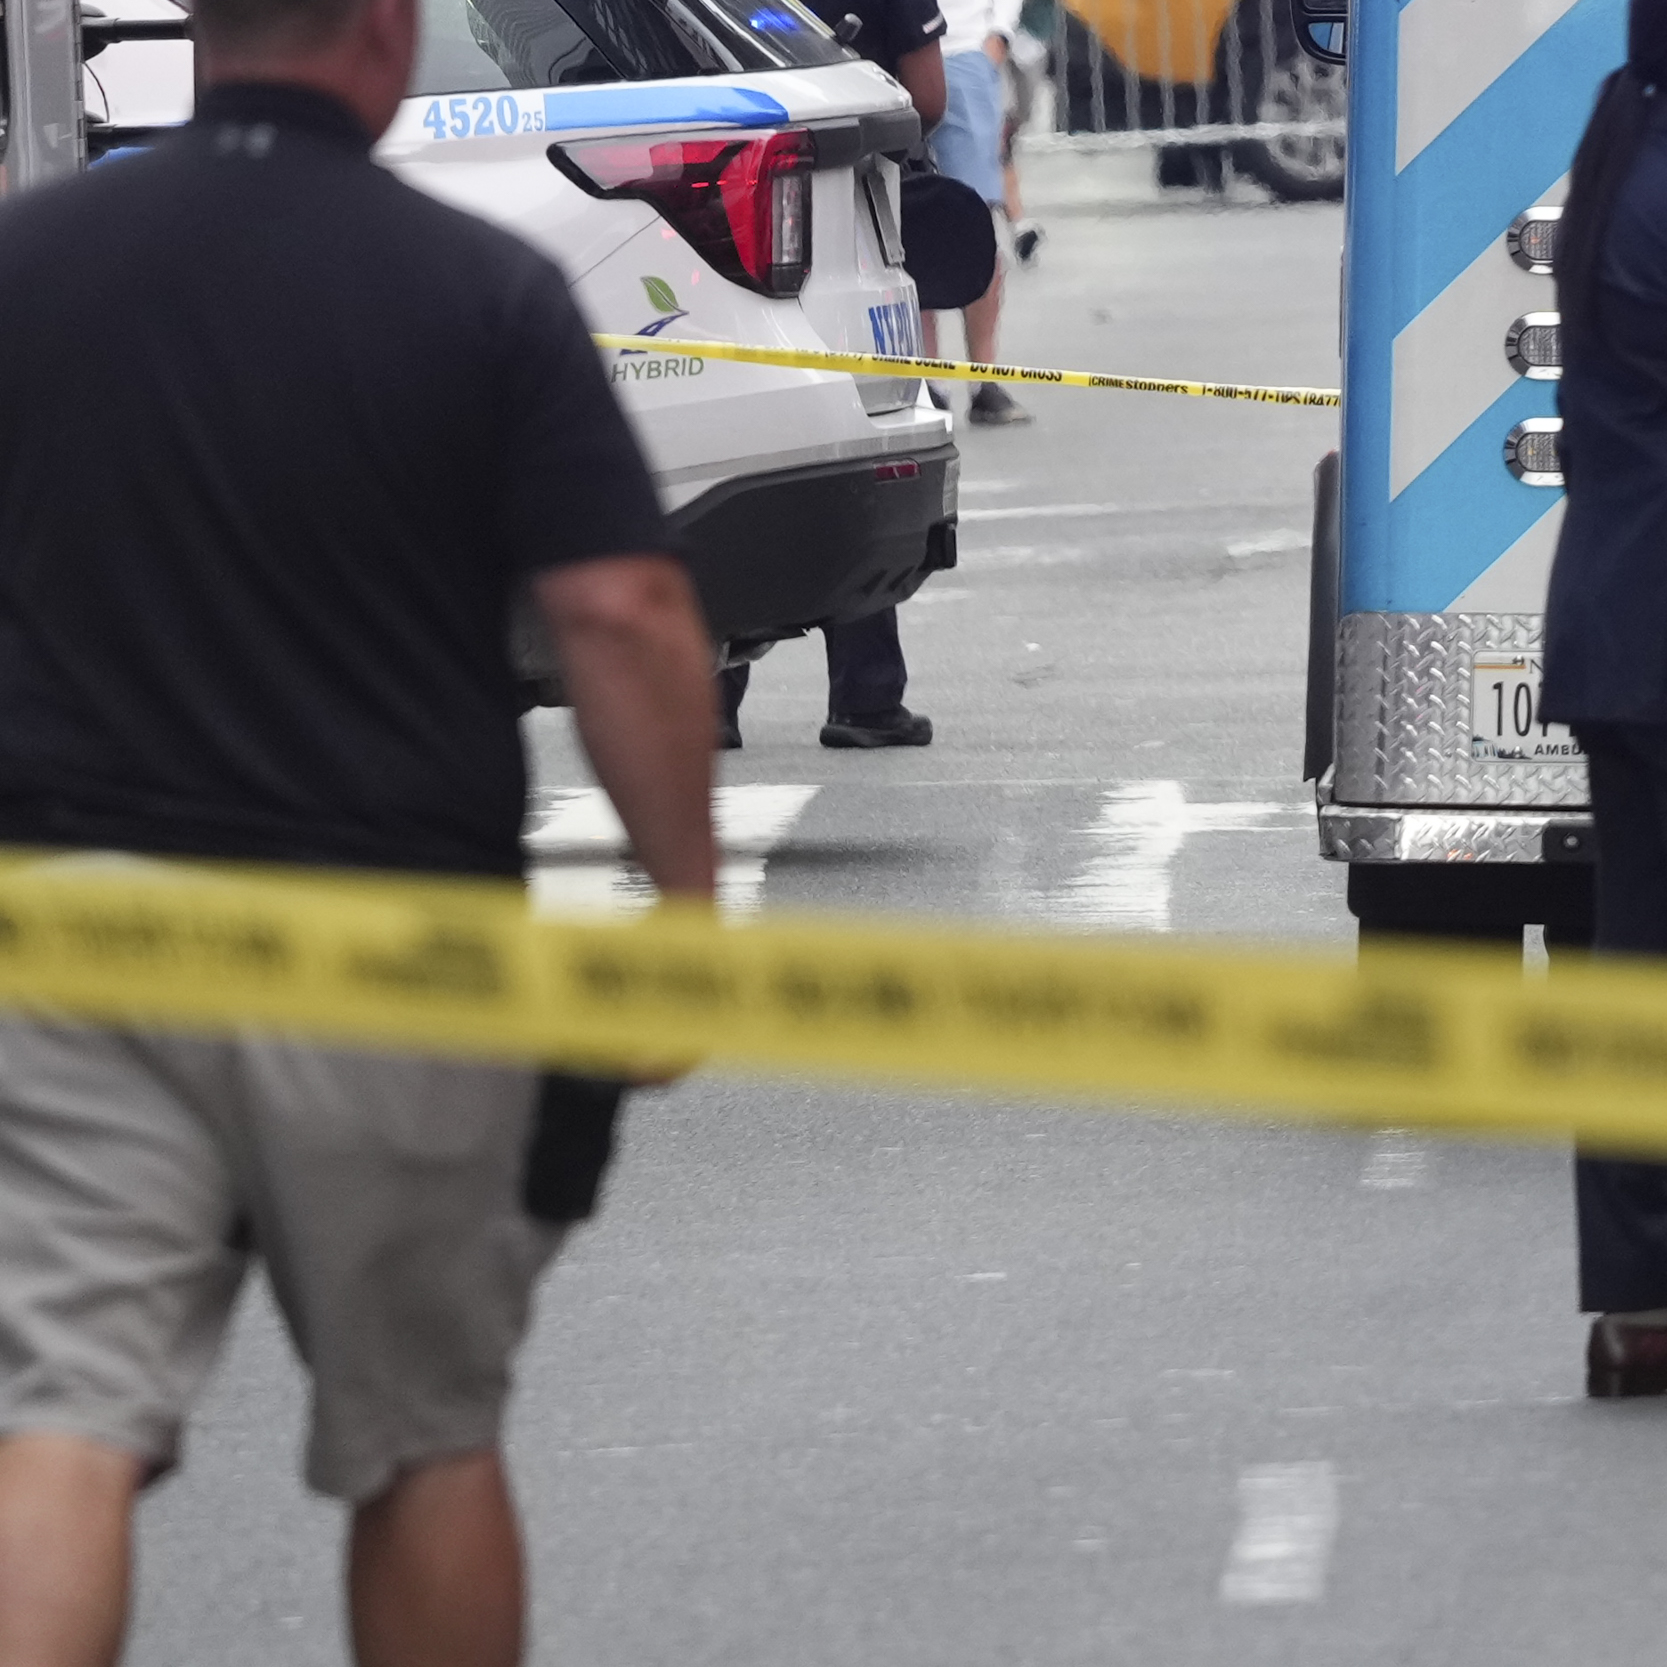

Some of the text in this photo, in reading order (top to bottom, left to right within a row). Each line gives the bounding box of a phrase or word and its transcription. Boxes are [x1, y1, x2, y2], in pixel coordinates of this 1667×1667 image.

[423, 95, 544, 139] 4520 25
[611, 357, 704, 383] HYBRID
